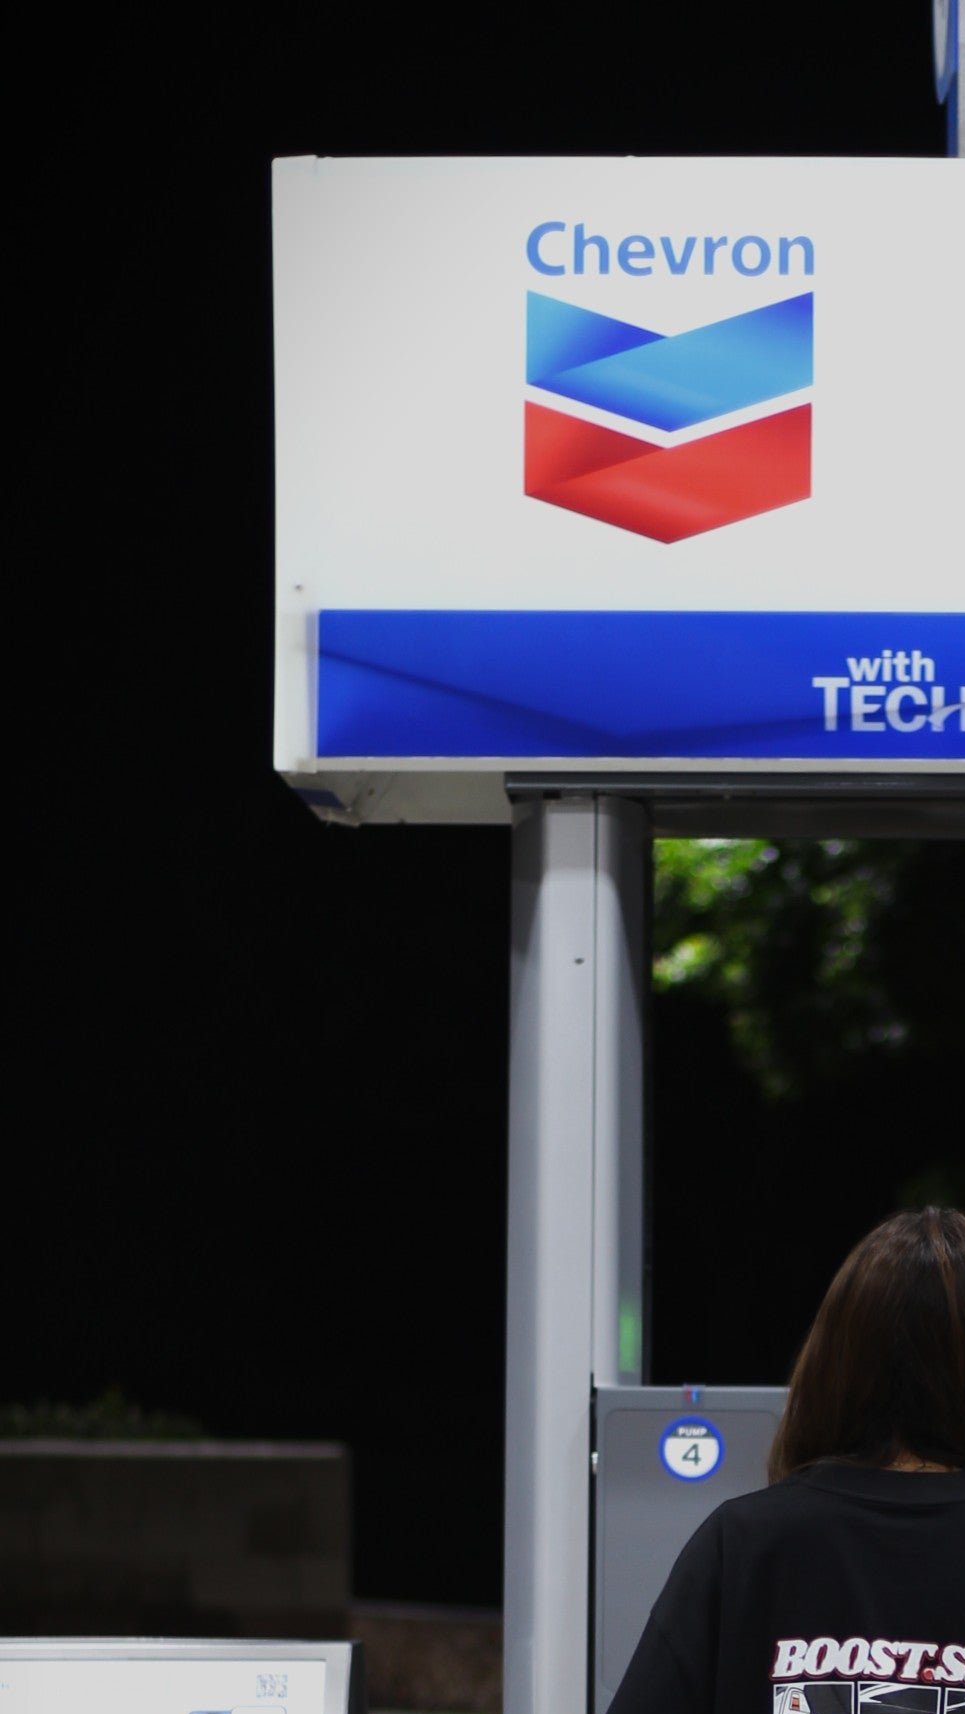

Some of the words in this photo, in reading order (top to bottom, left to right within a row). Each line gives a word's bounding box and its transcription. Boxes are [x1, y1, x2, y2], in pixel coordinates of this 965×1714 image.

[526, 221, 815, 276] Chevron
[846, 650, 935, 682] with
[678, 1426, 708, 1436] PUMP
[681, 1443, 702, 1467] 4
